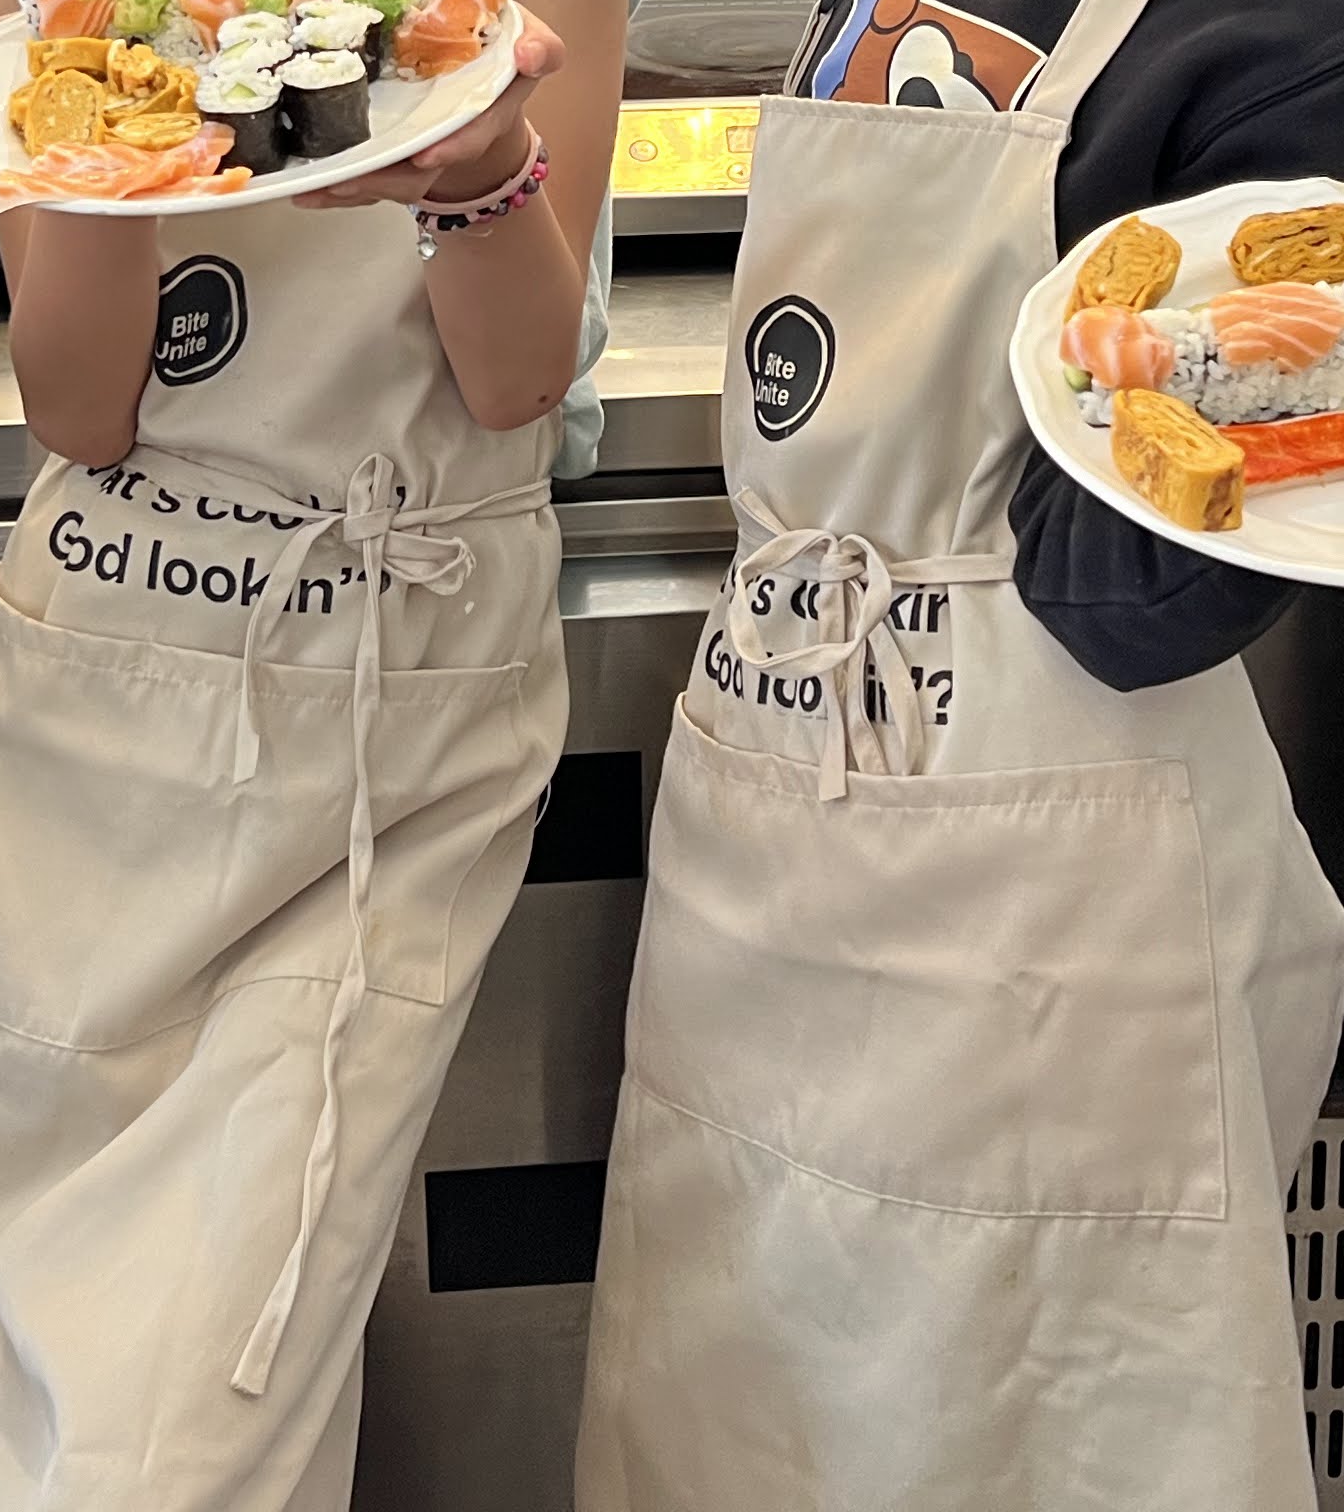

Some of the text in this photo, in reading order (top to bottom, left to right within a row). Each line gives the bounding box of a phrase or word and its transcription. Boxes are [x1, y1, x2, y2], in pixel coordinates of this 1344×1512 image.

[171, 311, 210, 338] Bite
[764, 352, 797, 380] Bite
[755, 378, 790, 407] Unite
